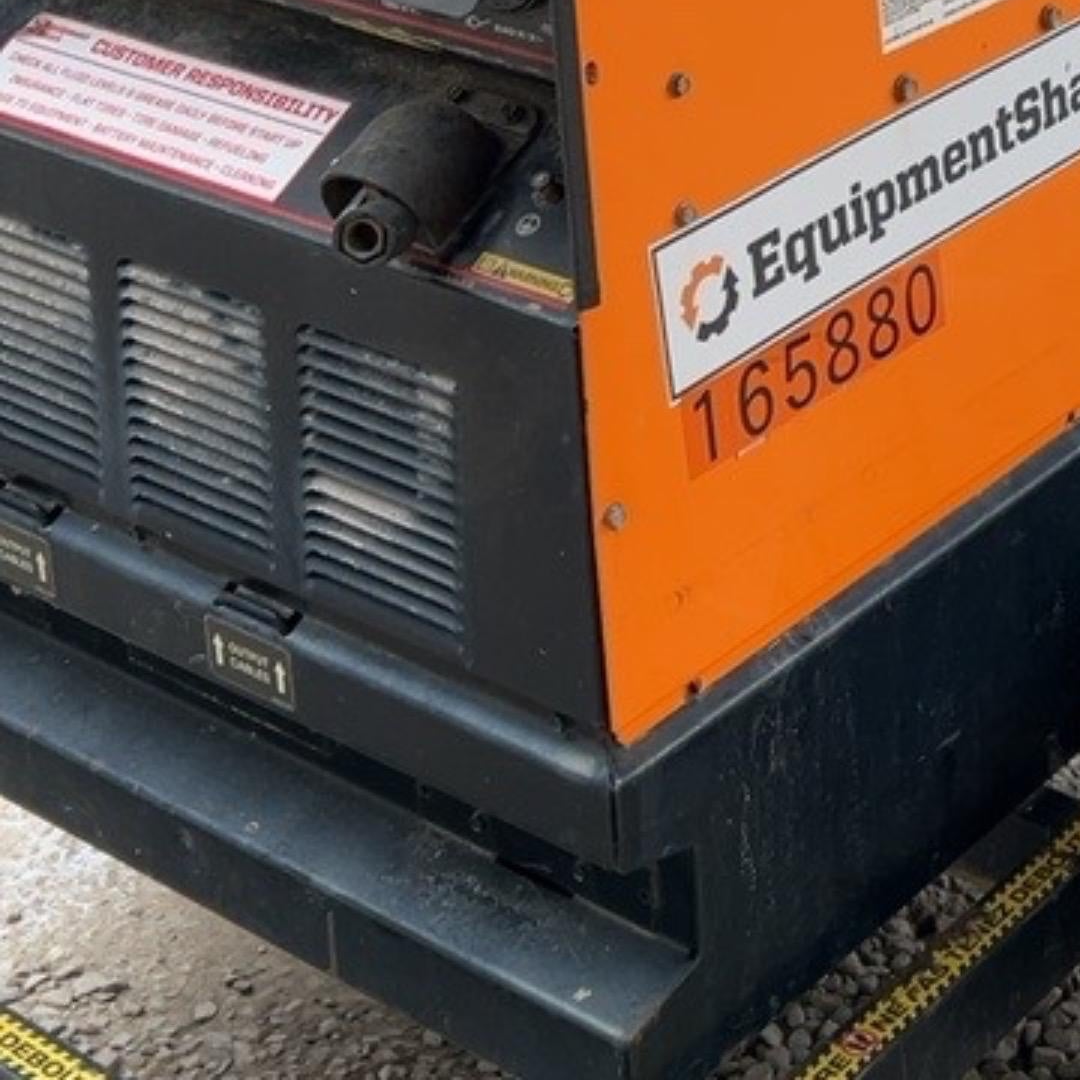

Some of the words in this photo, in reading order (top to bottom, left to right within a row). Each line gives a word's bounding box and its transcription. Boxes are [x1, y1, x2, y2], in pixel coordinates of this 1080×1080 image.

[91, 38, 187, 79] CUSTOMER
[184, 66, 340, 123] RESPONSIBILITY
[693, 262, 940, 462] 165880
